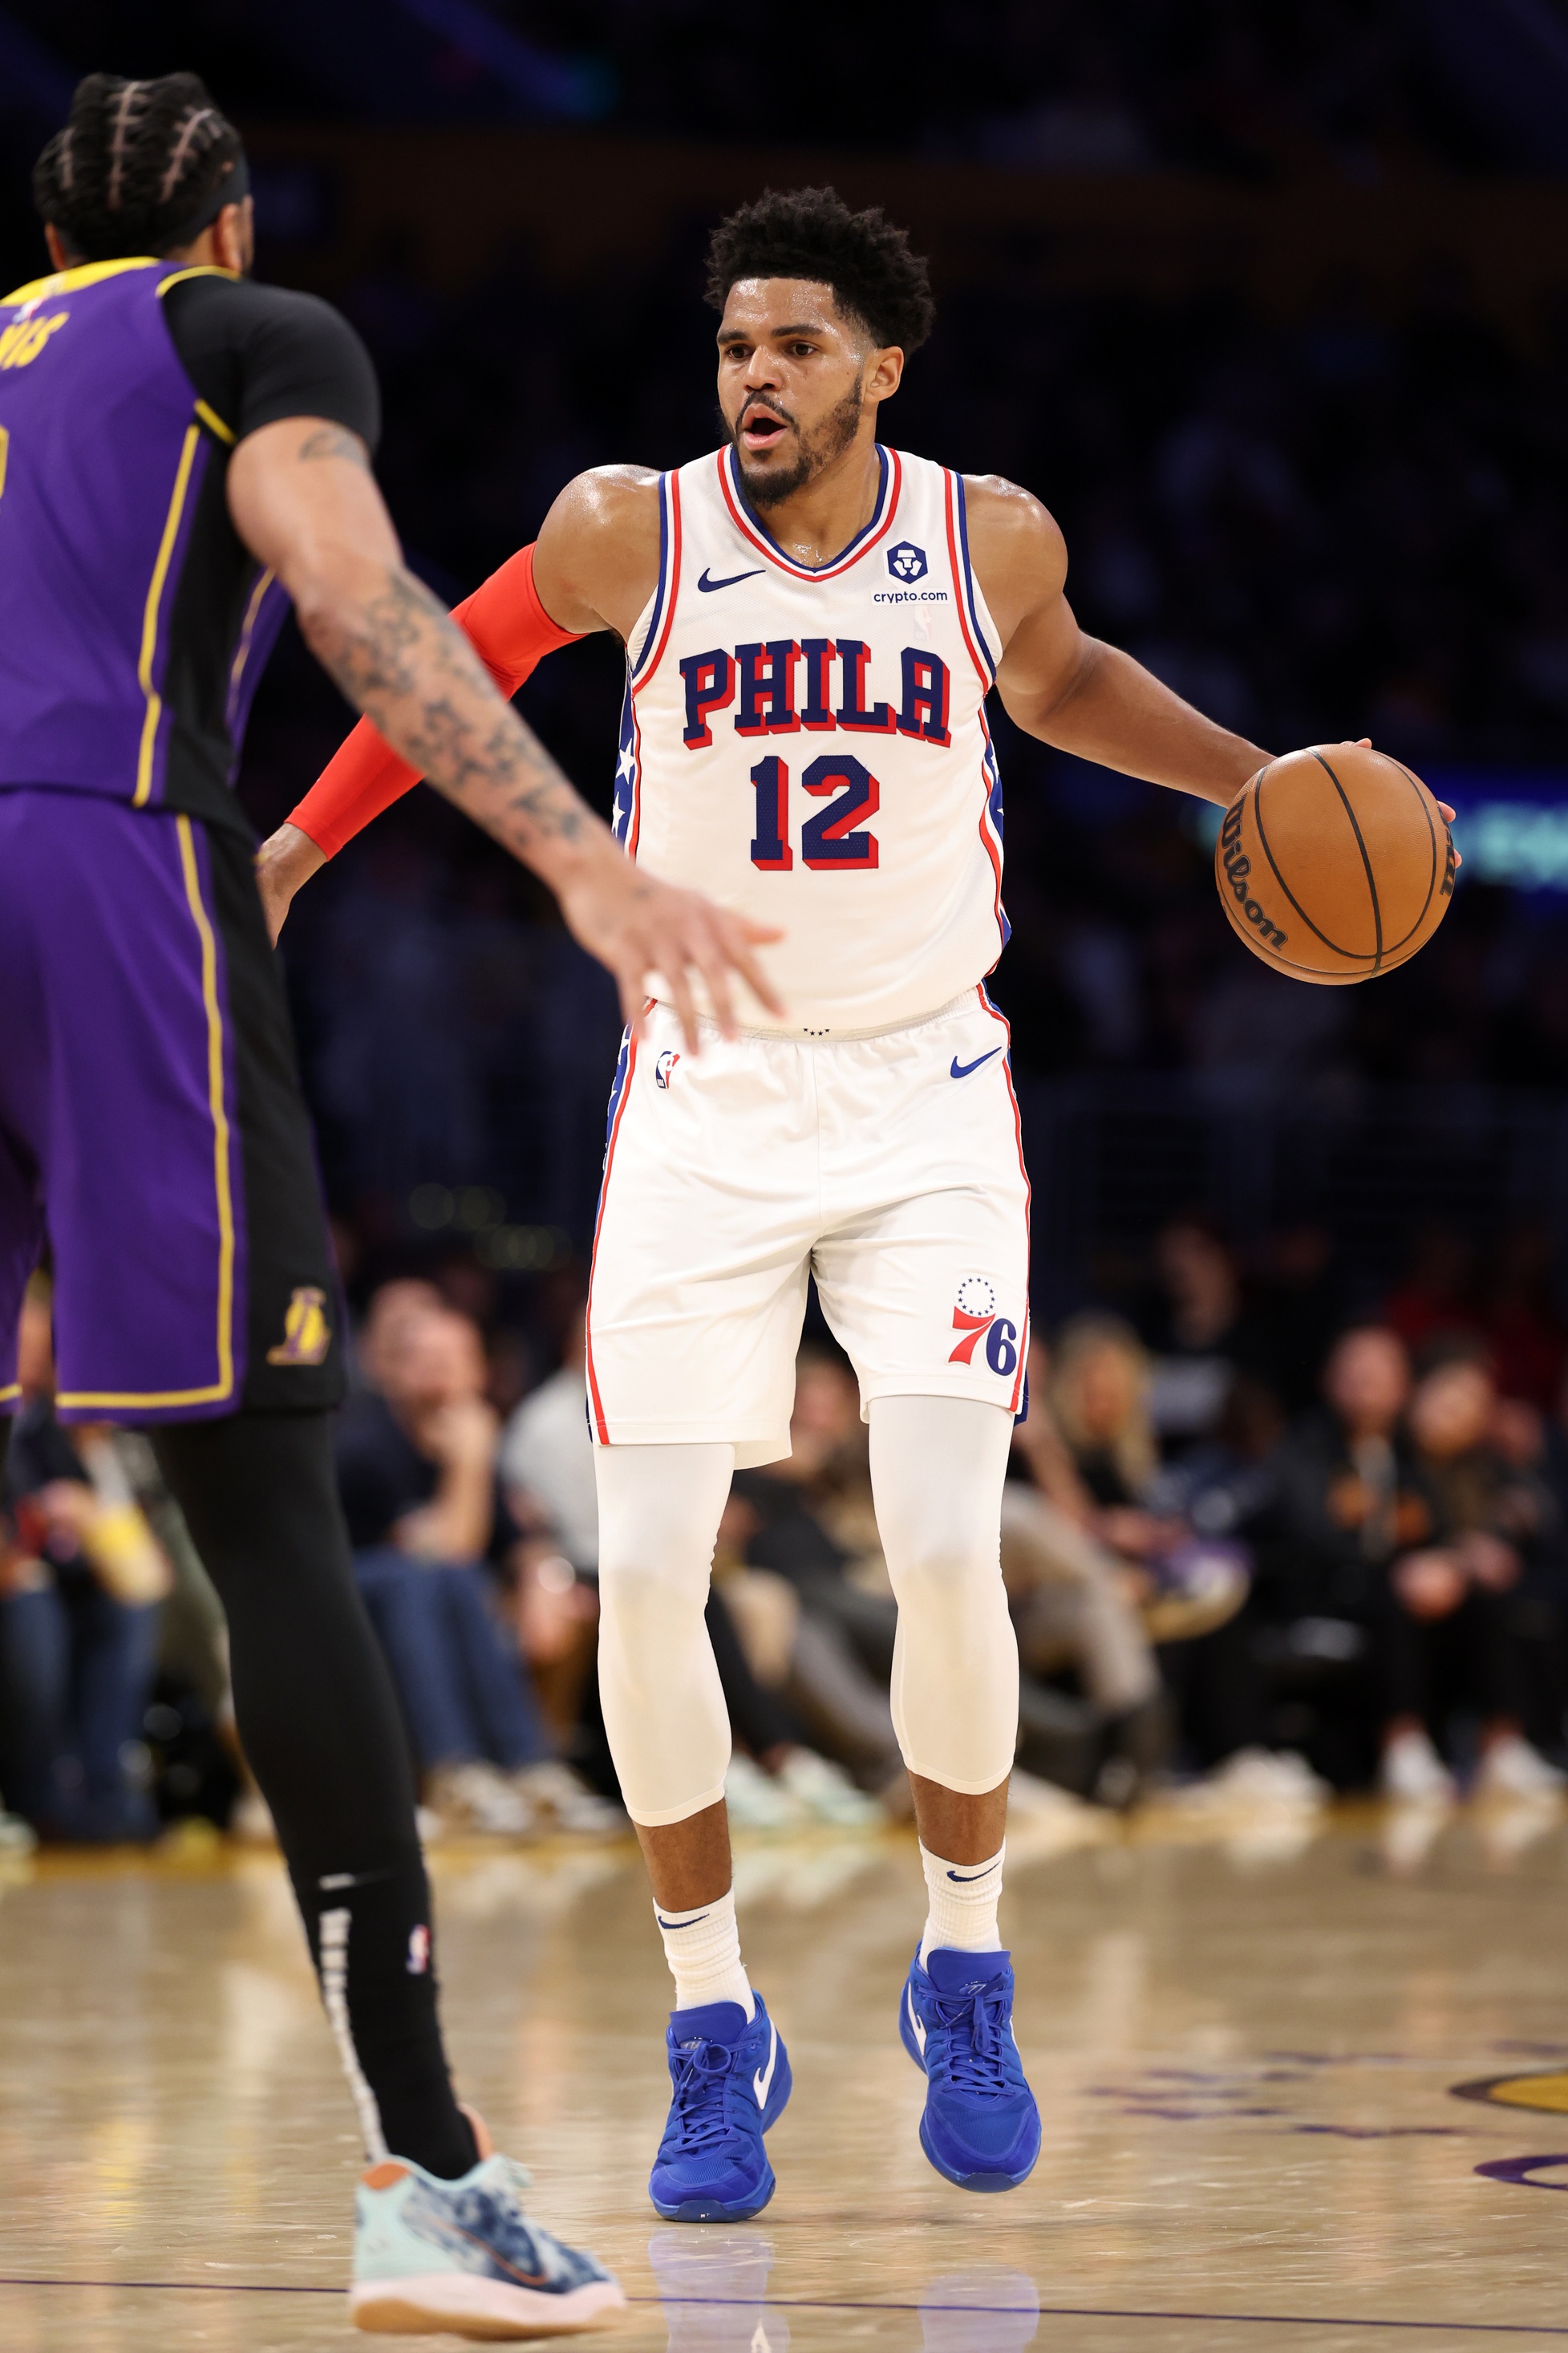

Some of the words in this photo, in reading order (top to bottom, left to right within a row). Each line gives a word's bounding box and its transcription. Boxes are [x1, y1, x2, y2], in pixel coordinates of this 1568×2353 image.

[873, 591, 948, 603] crypto.com
[679, 639, 951, 750] PHILA
[751, 755, 880, 870] 12
[1222, 794, 1288, 951] Wilson
[948, 1305, 1017, 1377] 76
